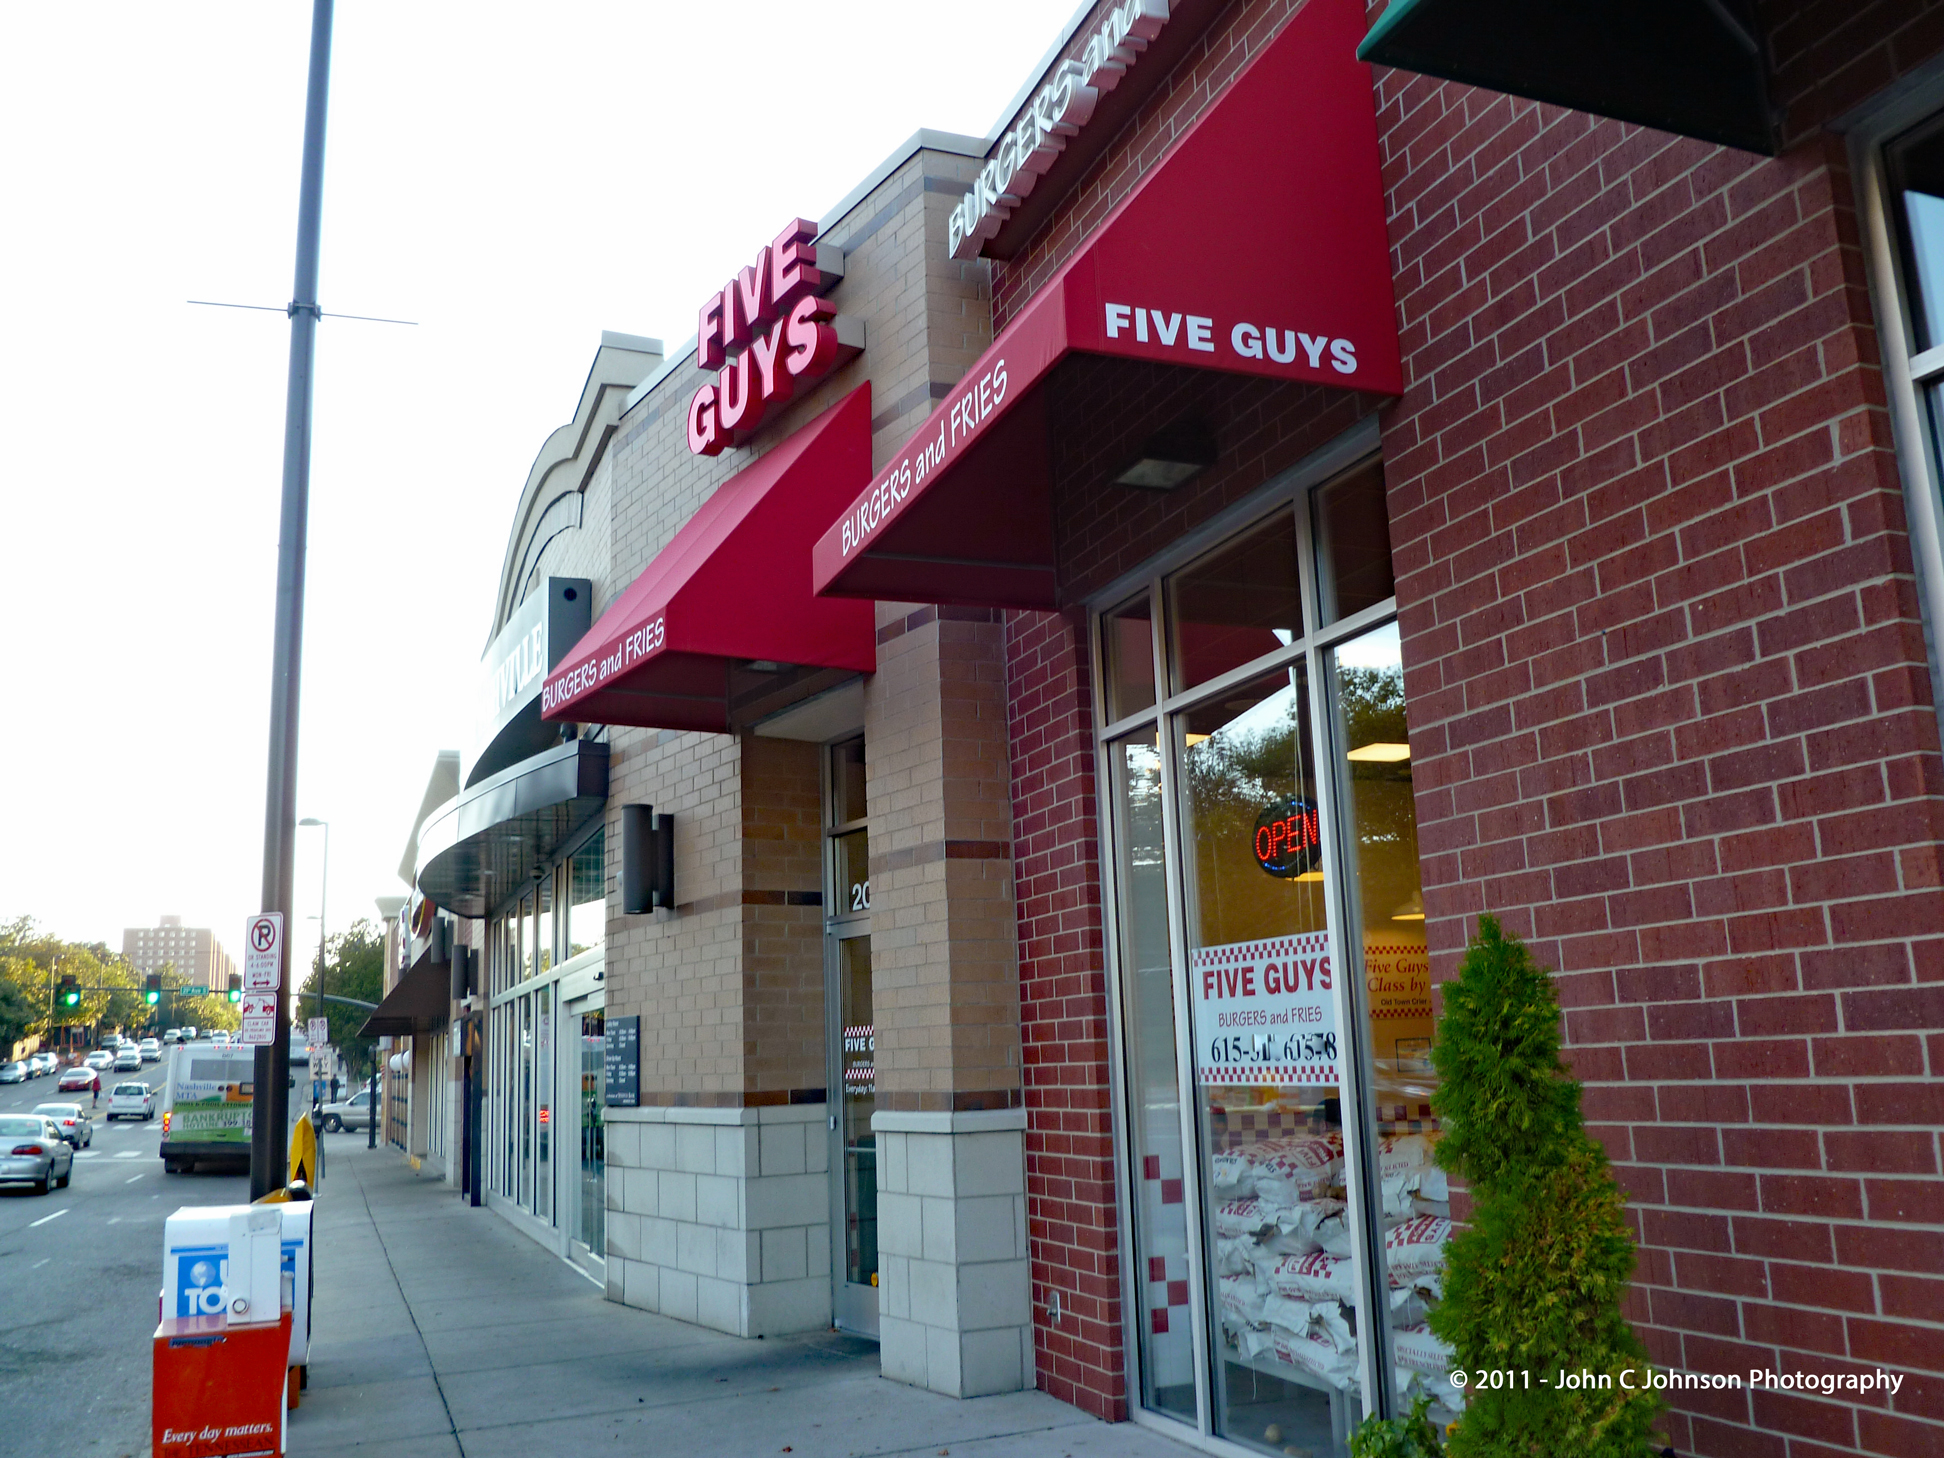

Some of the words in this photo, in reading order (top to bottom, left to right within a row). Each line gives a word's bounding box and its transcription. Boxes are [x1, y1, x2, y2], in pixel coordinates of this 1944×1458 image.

[949, 59, 1080, 260] BURGERS
[698, 217, 812, 368] FIVE
[1105, 303, 1214, 352] FIVE
[1231, 322, 1357, 374] GUYS
[688, 295, 828, 455] GUYS
[842, 459, 911, 557] BURGERS
[916, 420, 946, 484] and
[951, 359, 1007, 447] FRIES
[543, 659, 597, 712] BURGERS
[600, 643, 622, 680] and
[626, 617, 665, 665] FRIES
[1256, 809, 1317, 861] OPEN
[1203, 966, 1256, 1000] FIVE
[1264, 956, 1333, 995] GUYS
[1365, 959, 1391, 973] Five
[1396, 958, 1429, 977] Guys
[1367, 977, 1405, 993] Class
[1411, 976, 1426, 995] by
[1381, 998, 1392, 1006] Old
[1411, 997, 1427, 1005] Crier
[1219, 1010, 1267, 1028] BURGERS
[1270, 1008, 1289, 1025] and
[1292, 1006, 1323, 1023] FRIES
[845, 1037, 866, 1052] FIVE
[176, 1091, 198, 1100] MTA
[177, 1082, 217, 1091] Nashville
[162, 1427, 198, 1447] Every
[199, 1425, 222, 1444] day
[225, 1422, 274, 1438] matters.
[189, 1436, 274, 1456] TENNESSEAN
